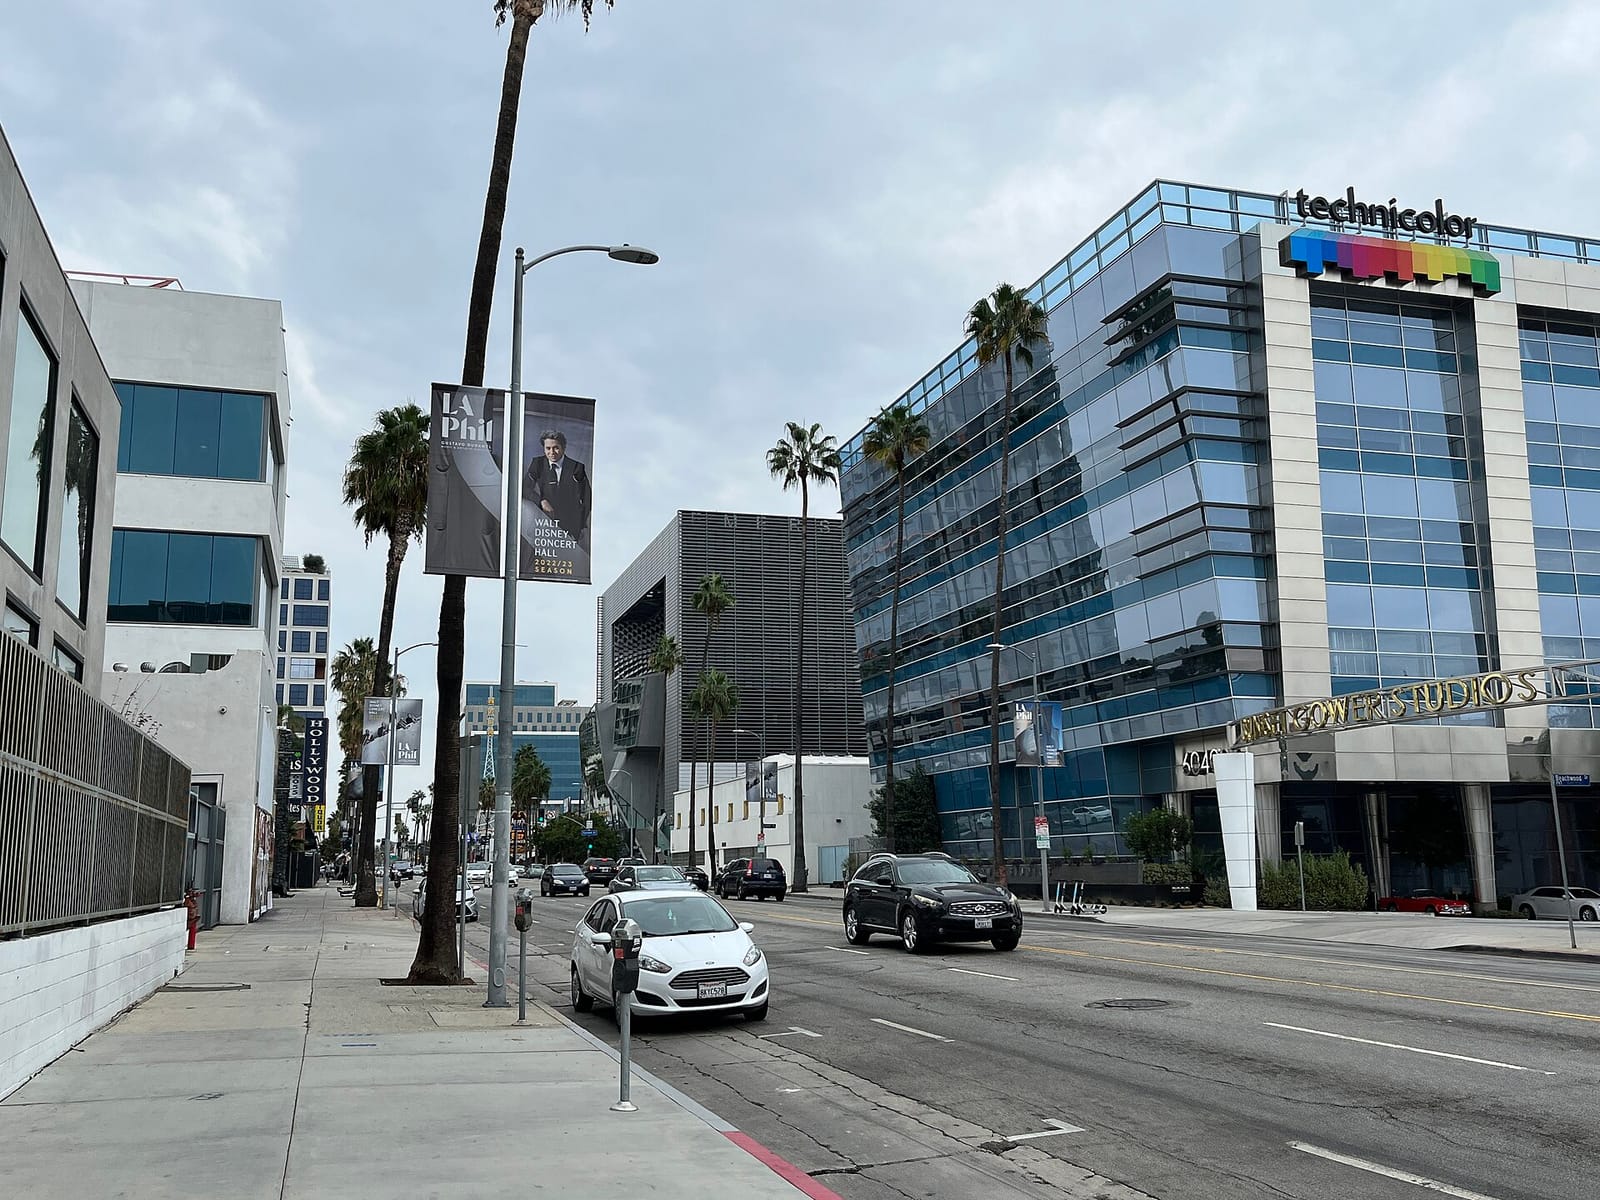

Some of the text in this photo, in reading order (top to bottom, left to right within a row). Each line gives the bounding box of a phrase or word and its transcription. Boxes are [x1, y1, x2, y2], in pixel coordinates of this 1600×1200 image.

[1297, 187, 1476, 239] technicolor
[443, 392, 475, 416] LA
[442, 416, 493, 442] Phil
[534, 518, 560, 528] WALT
[534, 528, 569, 539] DISNEY
[534, 538, 577, 549] CONCERT
[534, 547, 558, 558] HALL
[534, 559, 573, 568] 2022/23
[534, 566, 573, 575] SEASON
[1293, 693, 1387, 732] GOWER
[1390, 671, 1537, 717] STUDIOS
[398, 742, 411, 751] LA
[398, 750, 417, 760] Phil
[305, 719, 324, 803] HOLLYWOOD
